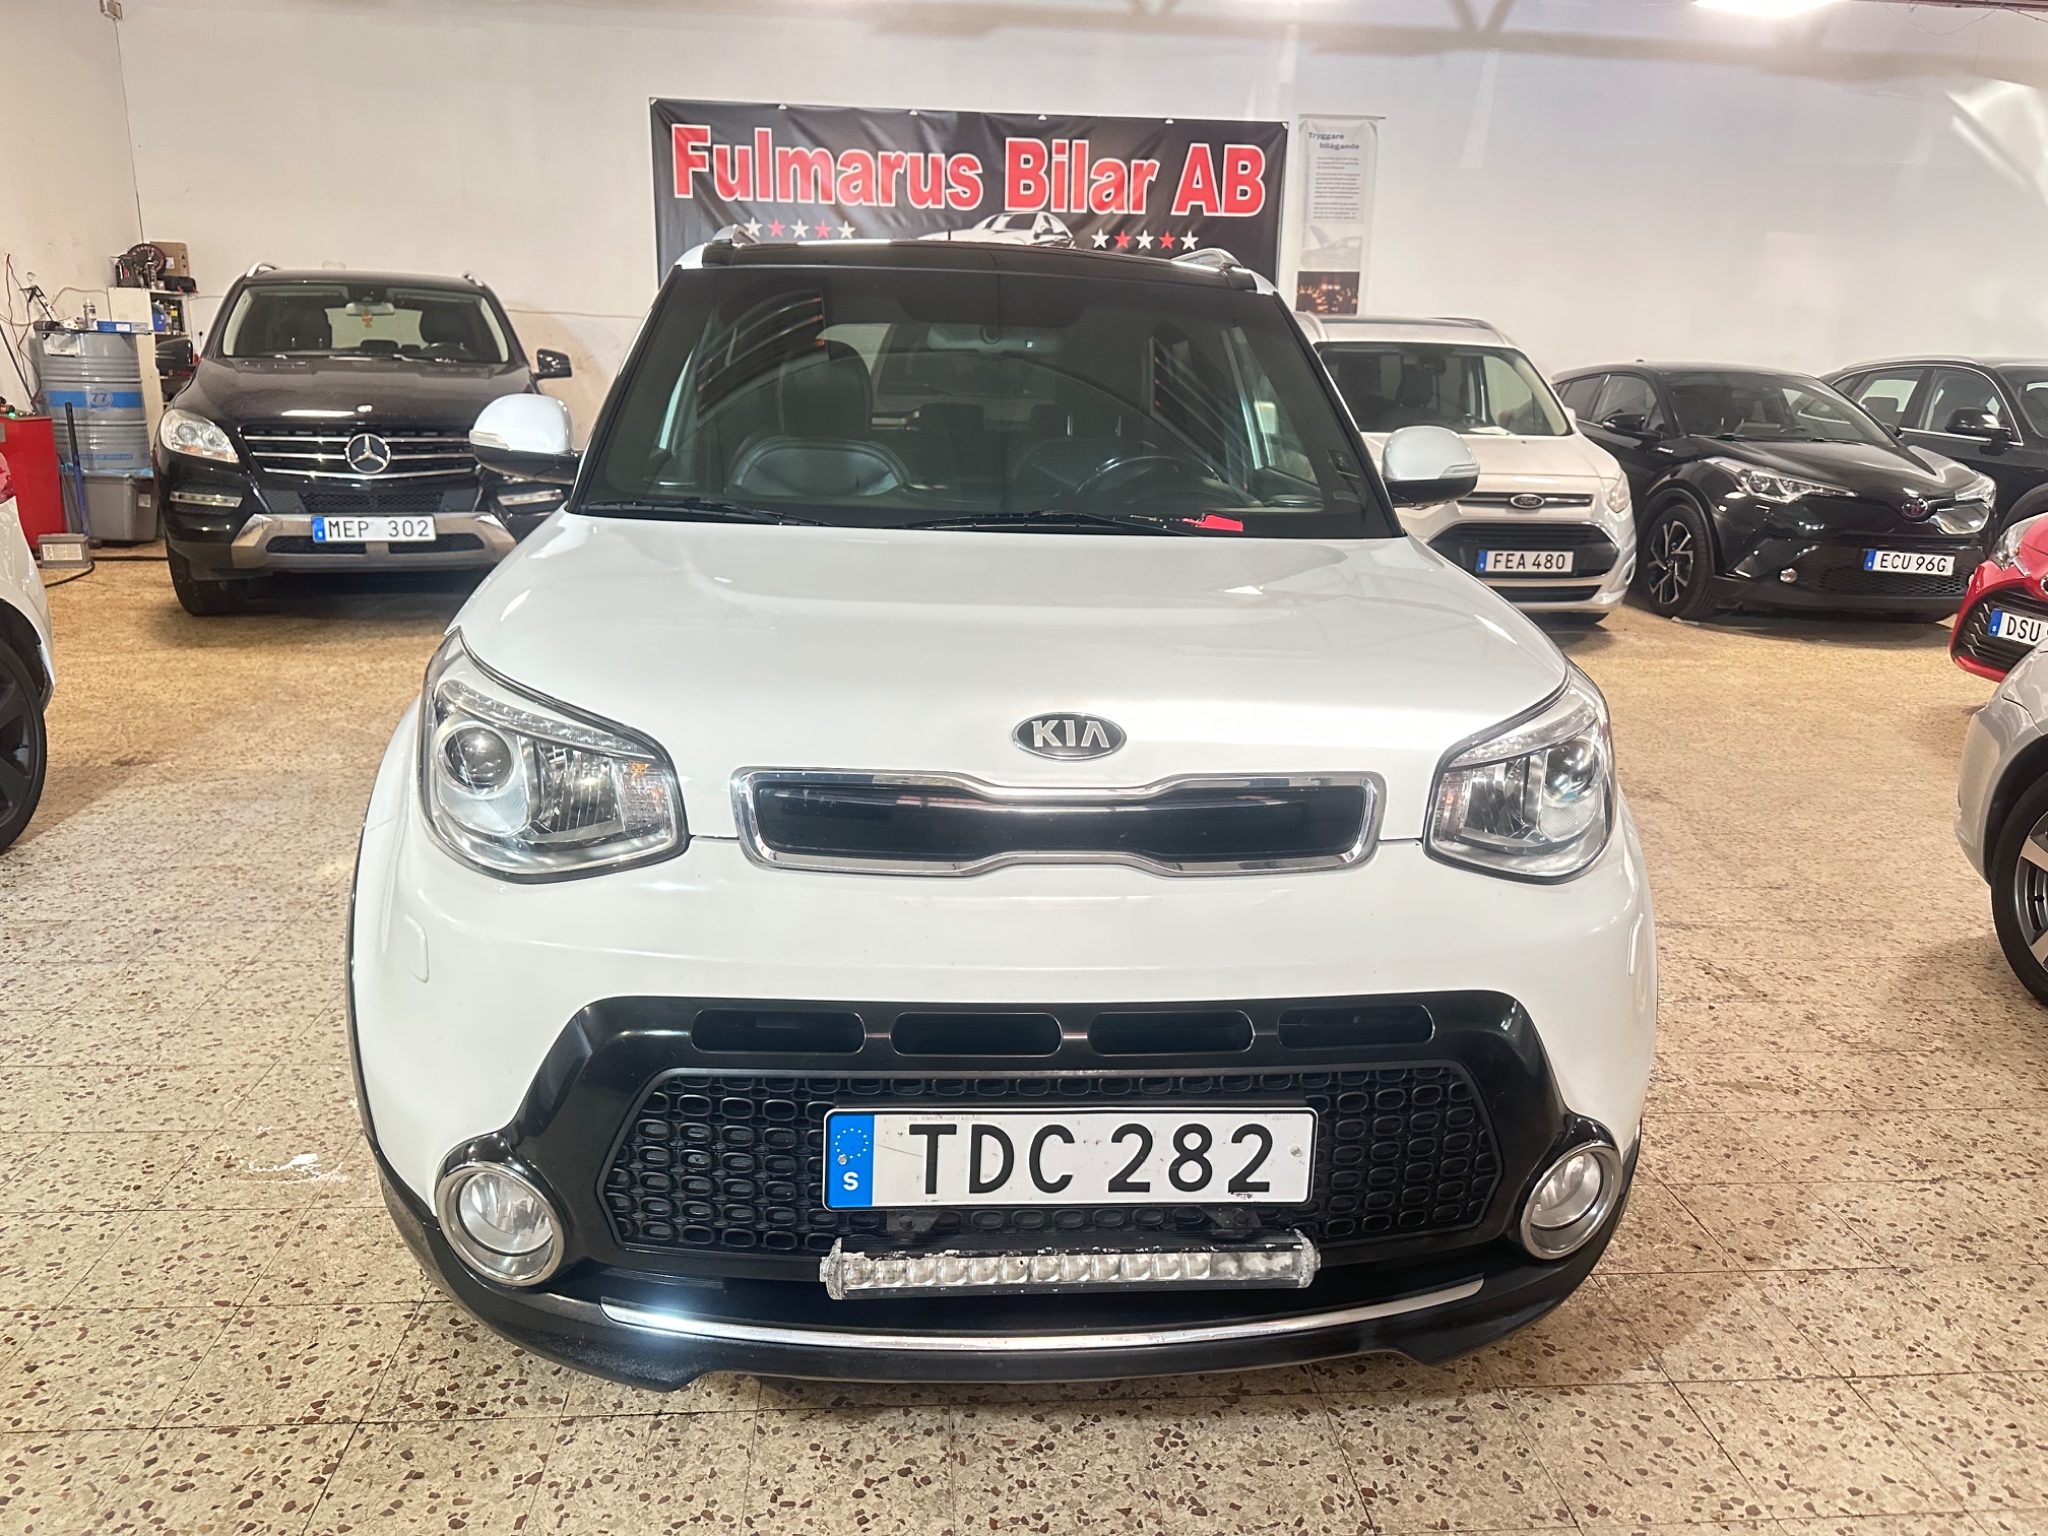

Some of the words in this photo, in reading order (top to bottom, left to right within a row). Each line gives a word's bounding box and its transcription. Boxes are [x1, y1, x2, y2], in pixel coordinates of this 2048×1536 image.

[1308, 132, 1345, 140] Tryggare
[671, 123, 984, 211] Fulmarus
[1005, 137, 1161, 216] Bilar
[1171, 142, 1268, 218] AB
[90, 392, 108, 403] 77
[328, 520, 370, 539] MEP
[388, 520, 430, 538] 302
[1493, 553, 1527, 569] FEA
[1532, 553, 1566, 570] 480
[1880, 553, 1912, 570] ECU
[1915, 556, 1947, 573] 96G
[2006, 615, 2042, 643] DSU
[1031, 719, 1110, 749] KIA
[908, 1123, 1076, 1195] TDC
[1106, 1123, 1274, 1194] 282
[842, 1171, 860, 1192] S
